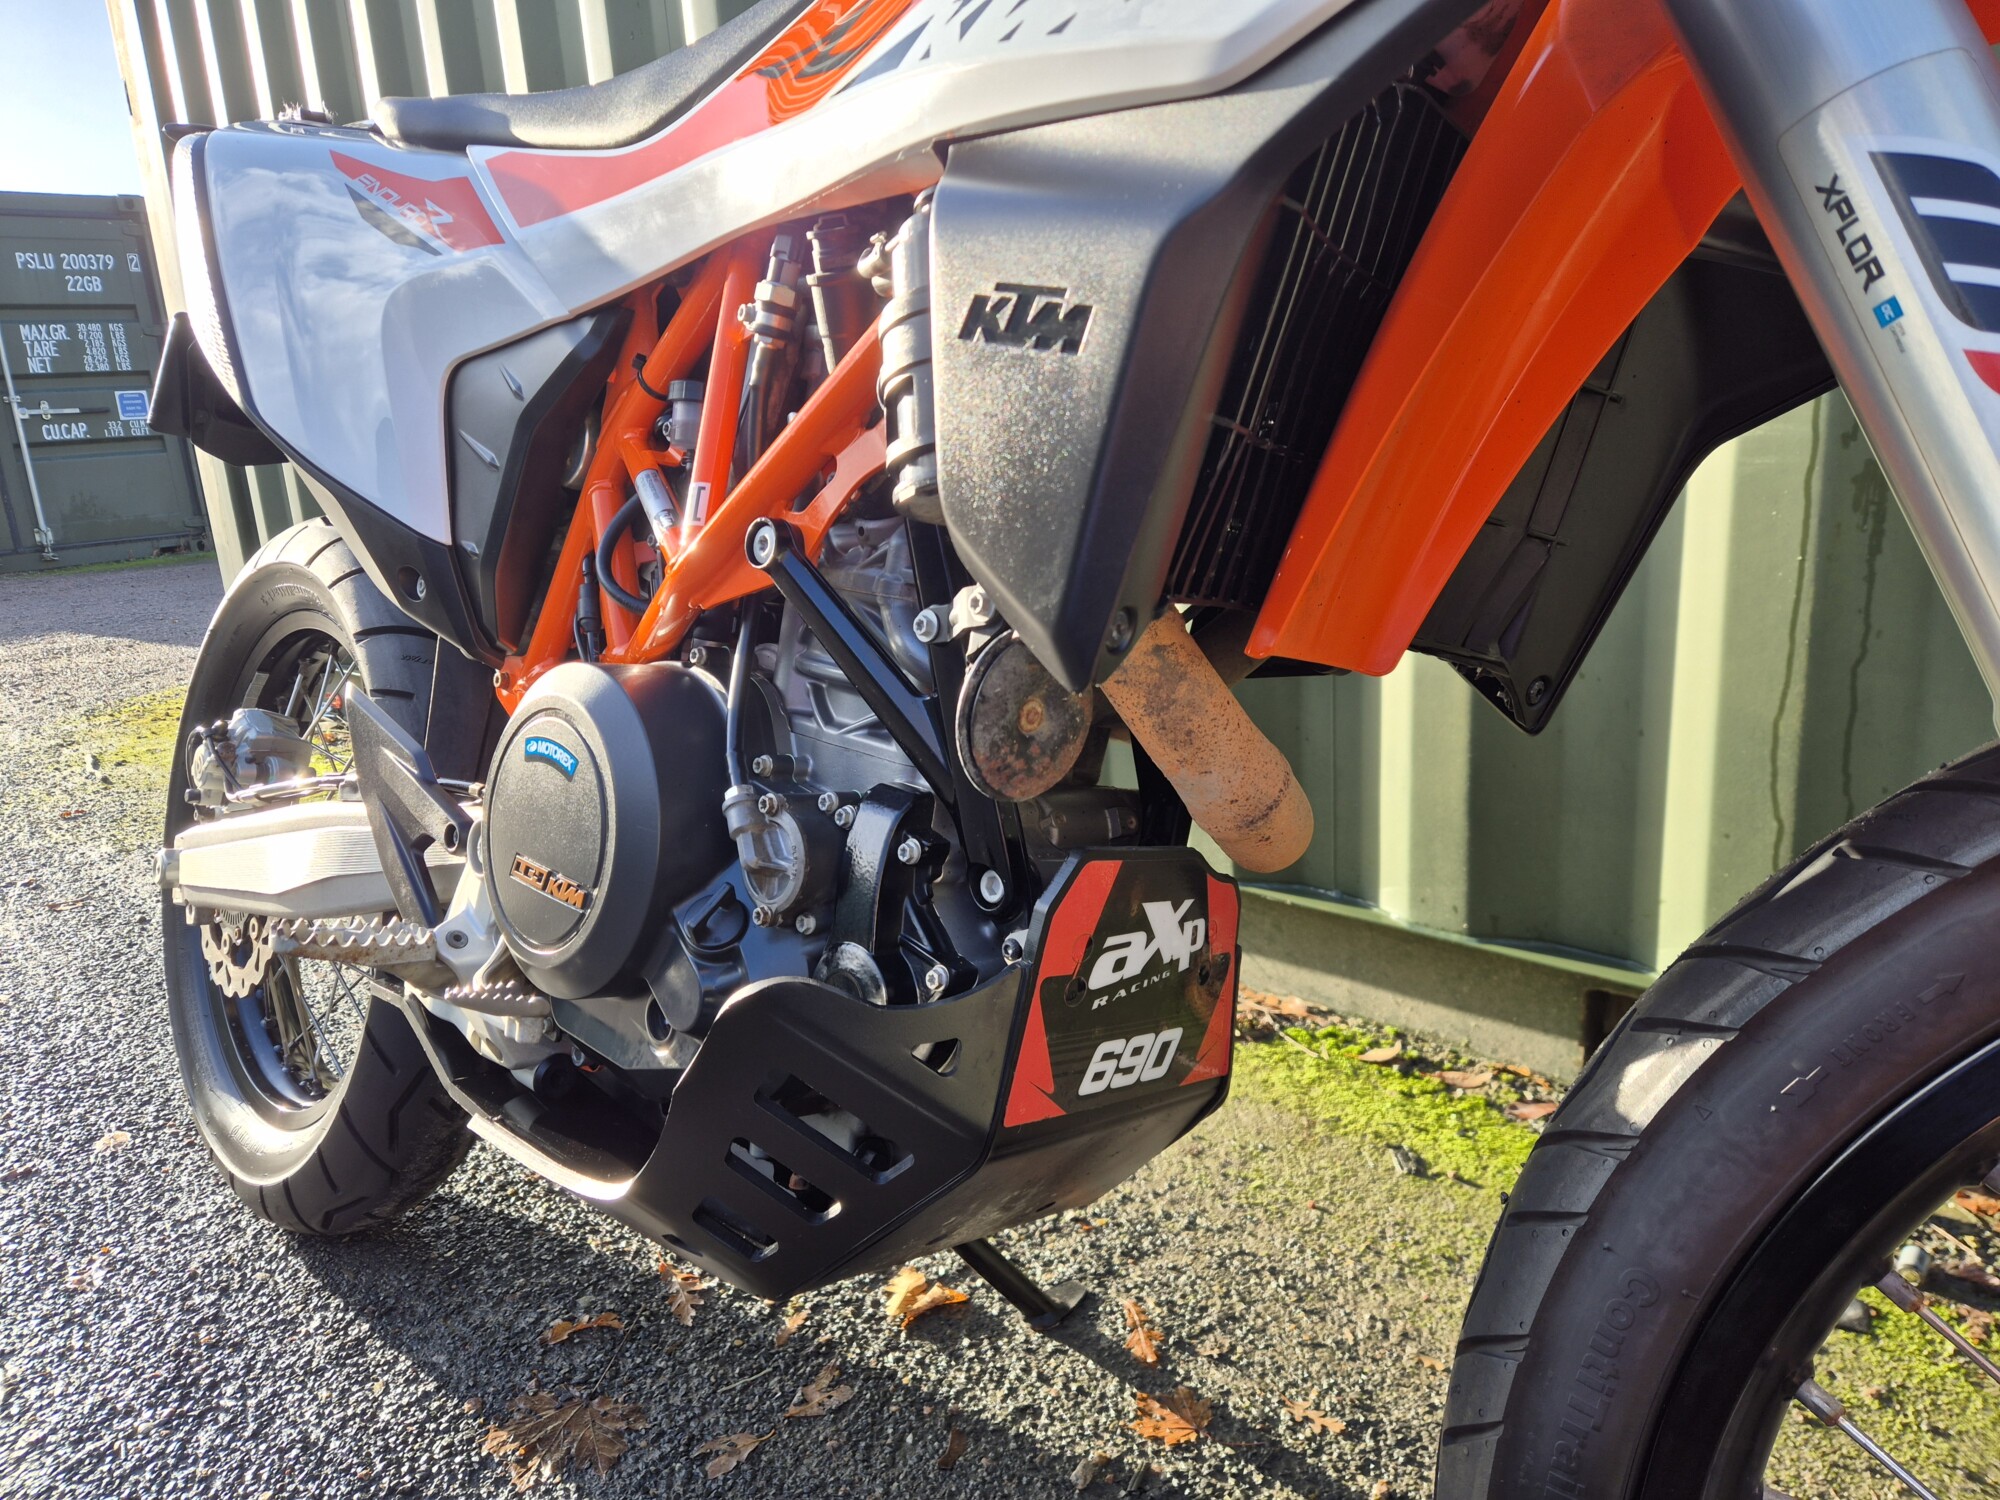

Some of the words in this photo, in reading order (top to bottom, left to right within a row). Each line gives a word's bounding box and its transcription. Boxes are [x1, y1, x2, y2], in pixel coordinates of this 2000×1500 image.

[1814, 172, 1885, 294] XPLOR
[15, 252, 55, 270] PSLU
[60, 253, 115, 270] 200379
[958, 282, 1094, 355] KTM
[19, 324, 71, 341] MAX.GR.
[109, 323, 124, 332] KGS
[110, 331, 126, 340] LBS
[23, 340, 61, 357] TARE
[112, 339, 127, 348] KGS
[113, 347, 128, 356] LBS
[27, 357, 53, 373] NET
[115, 355, 130, 363] KGS
[117, 363, 132, 371] LBS
[42, 423, 91, 440] CU.CAP.
[536, 740, 575, 772] MOTOREX
[545, 873, 586, 910] KTM
[1091, 970, 1171, 1011] RACING
[1078, 1027, 1184, 1096] 690
